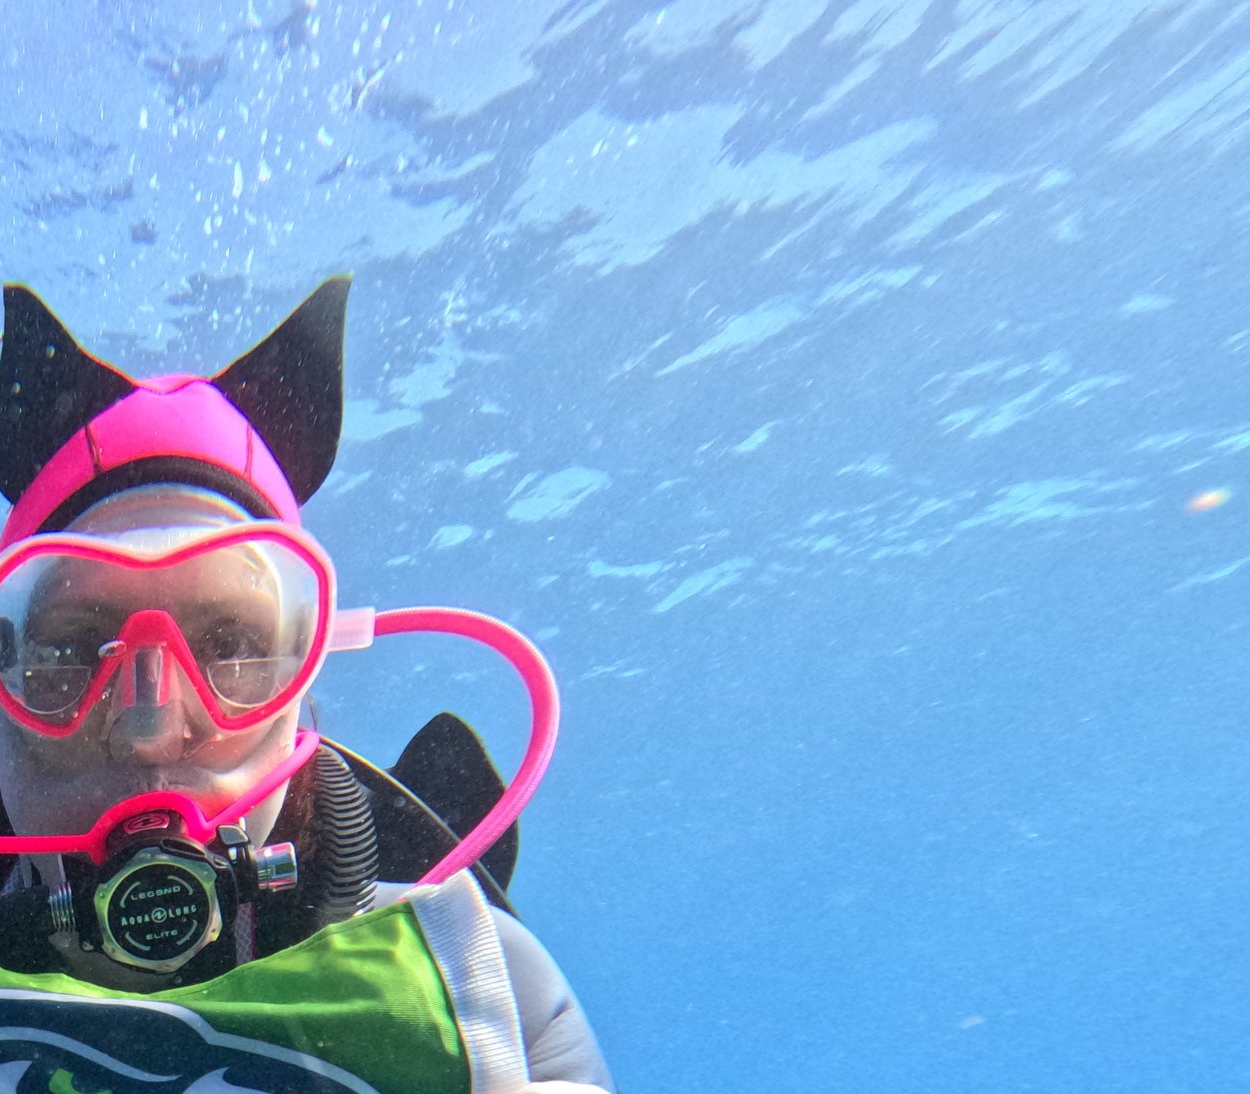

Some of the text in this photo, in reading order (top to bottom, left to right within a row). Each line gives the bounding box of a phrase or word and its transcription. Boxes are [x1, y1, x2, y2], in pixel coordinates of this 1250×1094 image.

[121, 904, 197, 927] AQUA LUNG
[145, 929, 178, 941] ELITE
